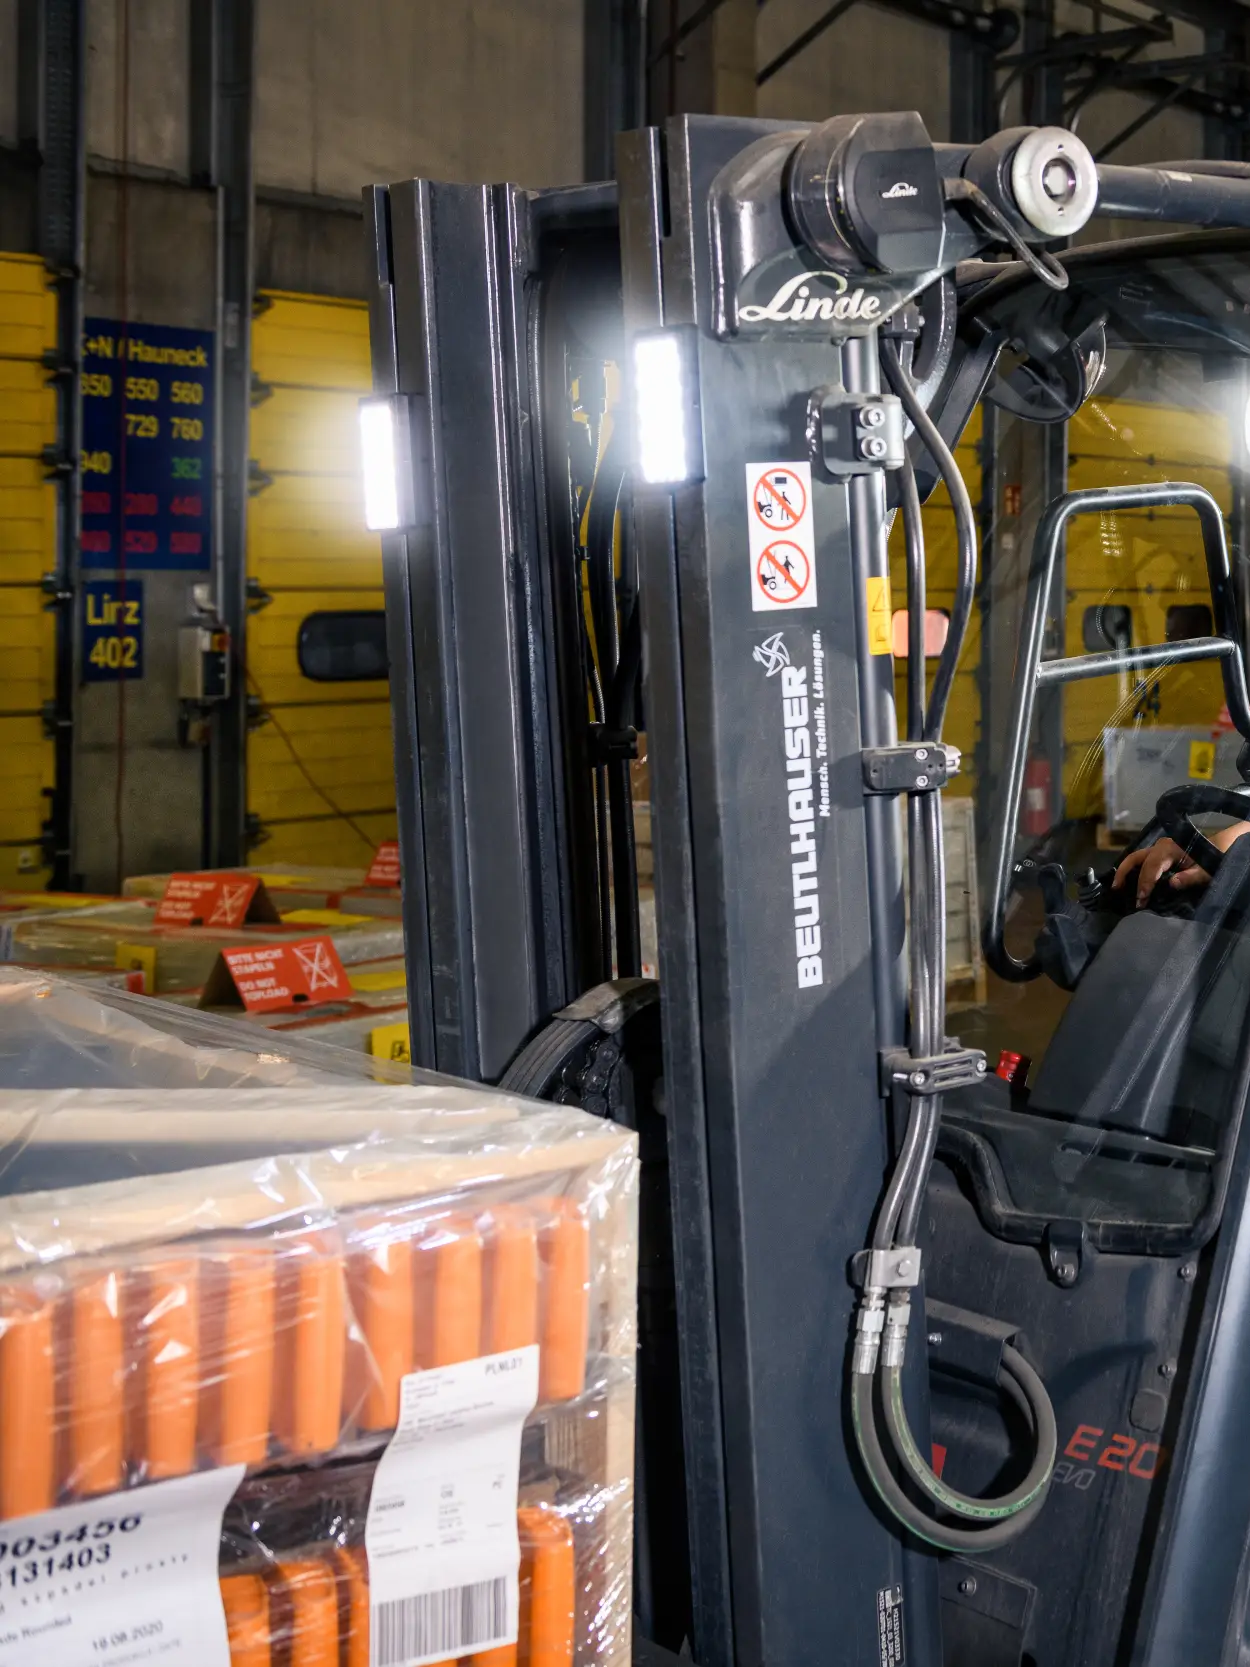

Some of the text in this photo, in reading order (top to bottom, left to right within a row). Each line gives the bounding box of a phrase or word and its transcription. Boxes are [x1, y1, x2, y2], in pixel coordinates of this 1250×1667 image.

[882, 182, 918, 199] Linde
[738, 270, 882, 322] Linde
[128, 338, 207, 367] Hauneck
[90, 636, 138, 668] 402
[811, 629, 831, 818] Mensch. Technik. Lösungen.
[781, 665, 824, 989] BEUTLHAUSER
[1053, 1462, 1096, 1491] EVO
[0, 1511, 144, 1563] 03456
[0, 1543, 111, 1588] 131403
